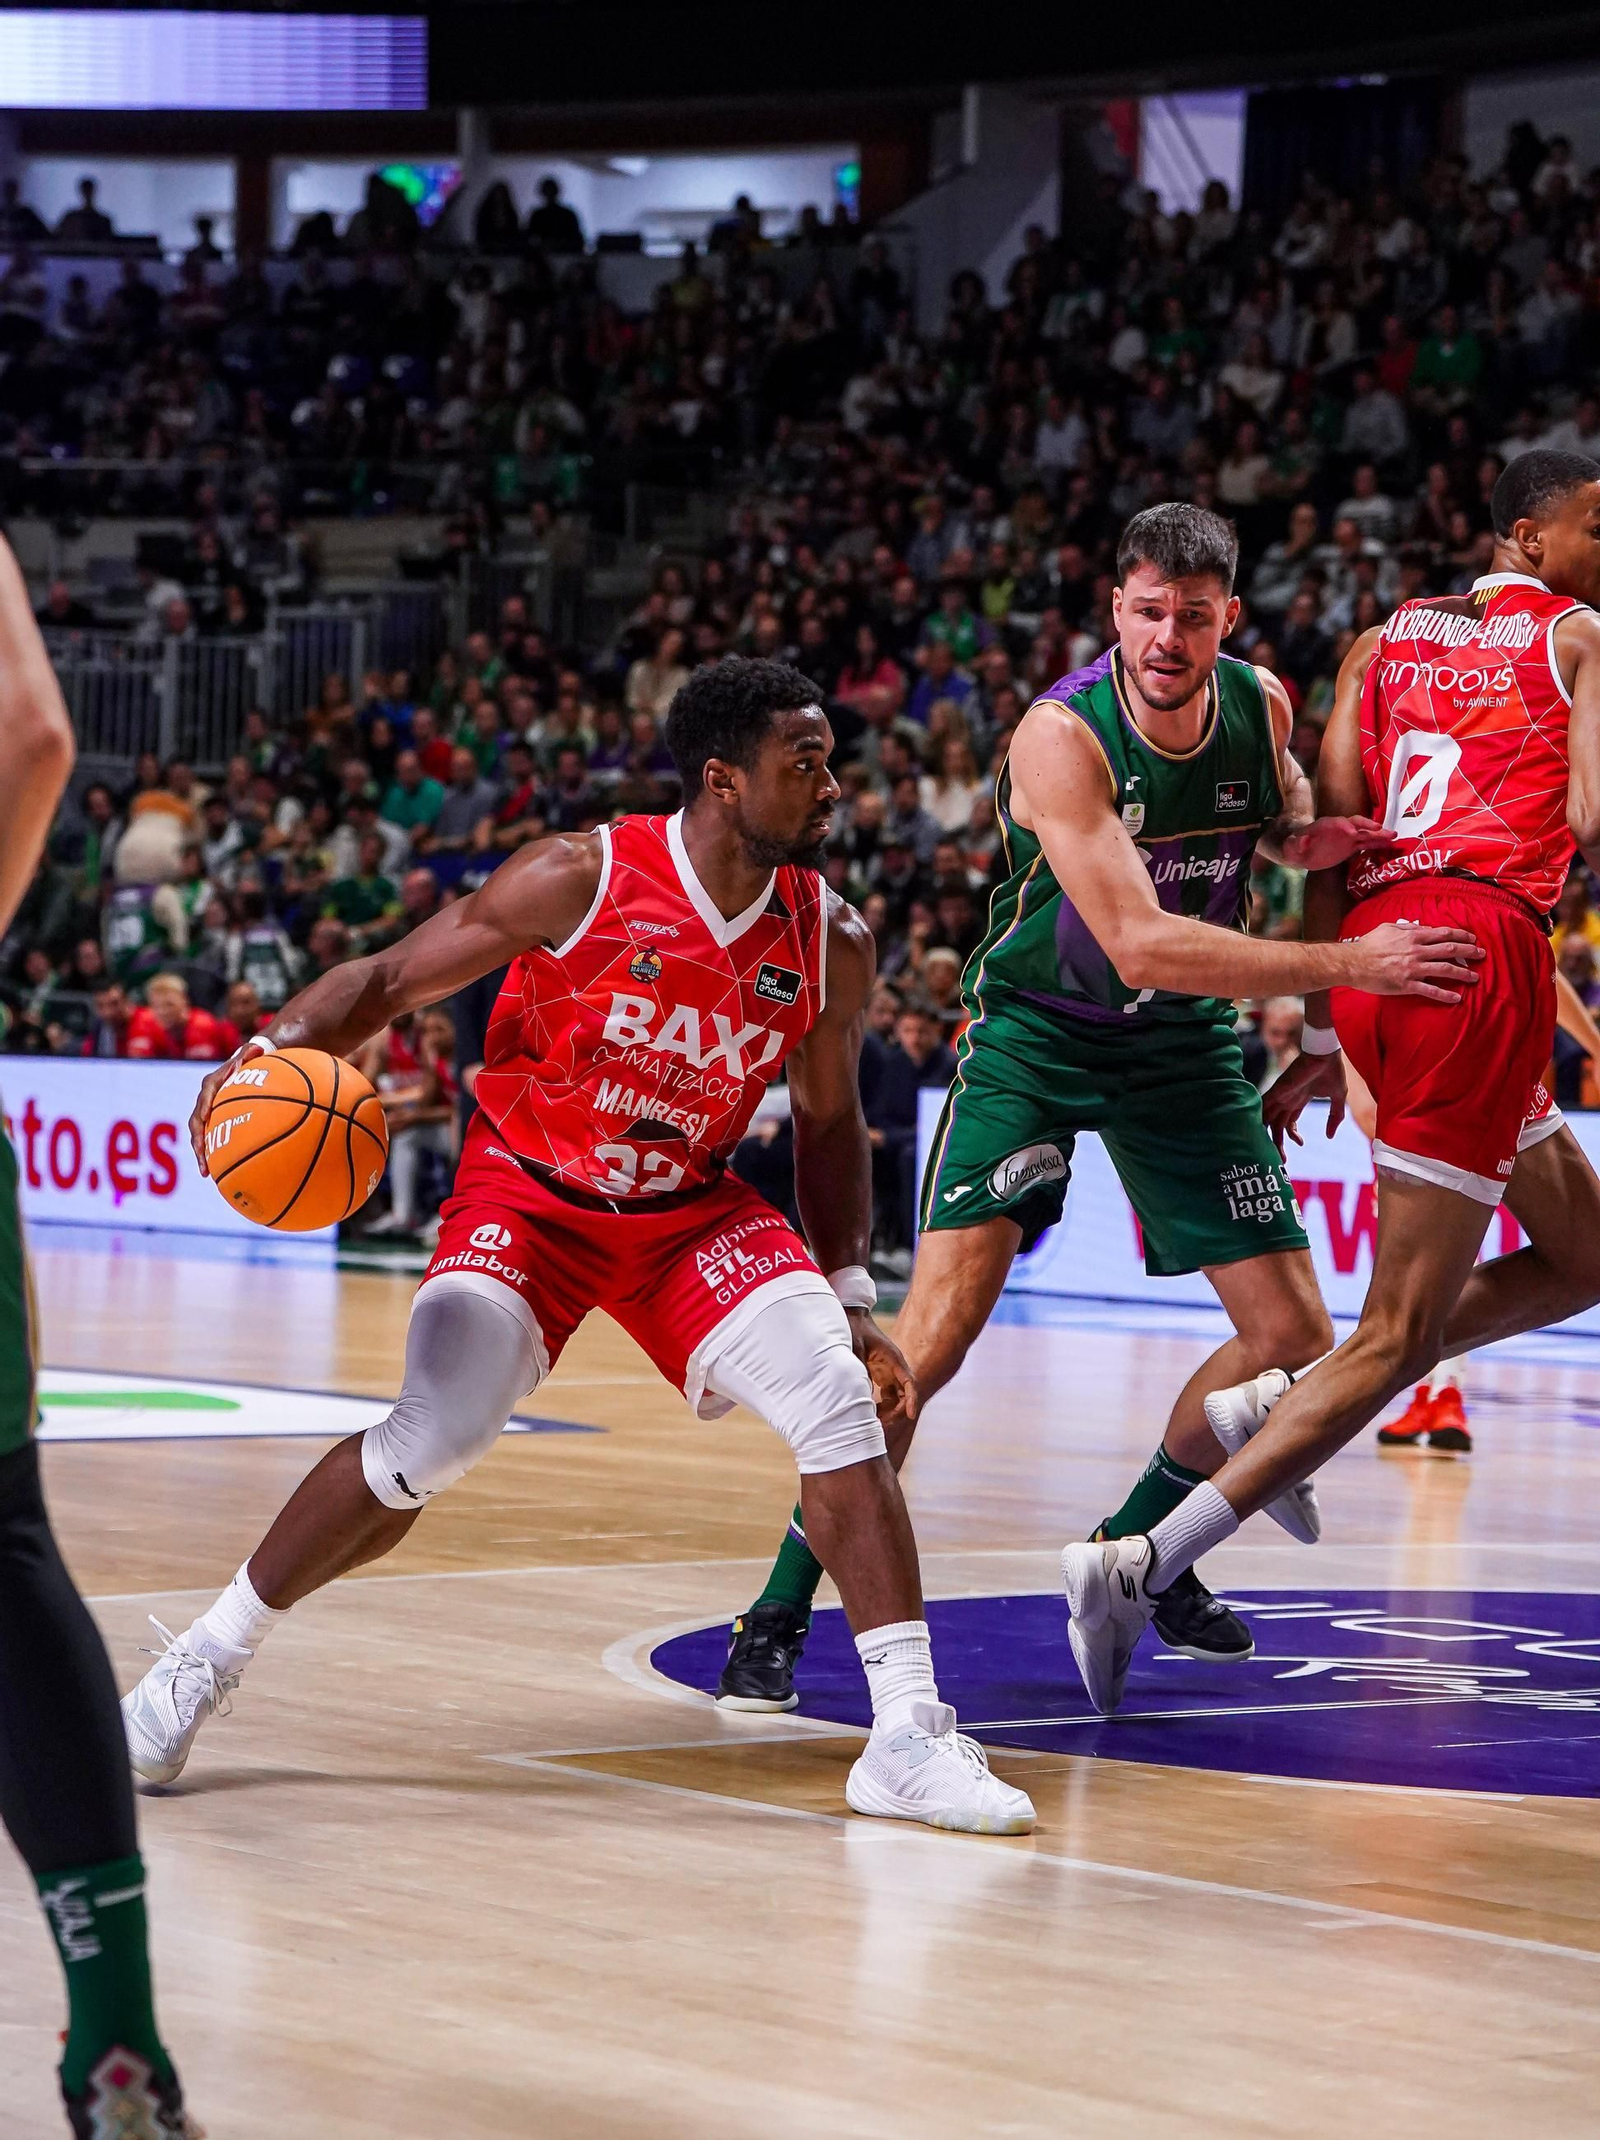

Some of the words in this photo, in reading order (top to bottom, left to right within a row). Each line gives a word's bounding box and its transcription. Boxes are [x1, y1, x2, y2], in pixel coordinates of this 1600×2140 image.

[1453, 697, 1465, 710] by
[1466, 696, 1509, 708] AVINENT
[1155, 853, 1240, 885] Unicaja
[759, 984, 793, 1000] endesa
[761, 973, 777, 986] liga
[602, 991, 785, 1081] BAXI
[232, 1112, 252, 1126] NXT
[4, 1098, 178, 1196] to.es
[1220, 1163, 1260, 1181] sabor
[1222, 1184, 1233, 1194] a
[1233, 1165, 1282, 1199] má
[1227, 1195, 1286, 1223] laga
[430, 1250, 529, 1286] unilabor
[701, 1246, 755, 1289] ETL
[716, 1247, 803, 1305] GLOBAL
